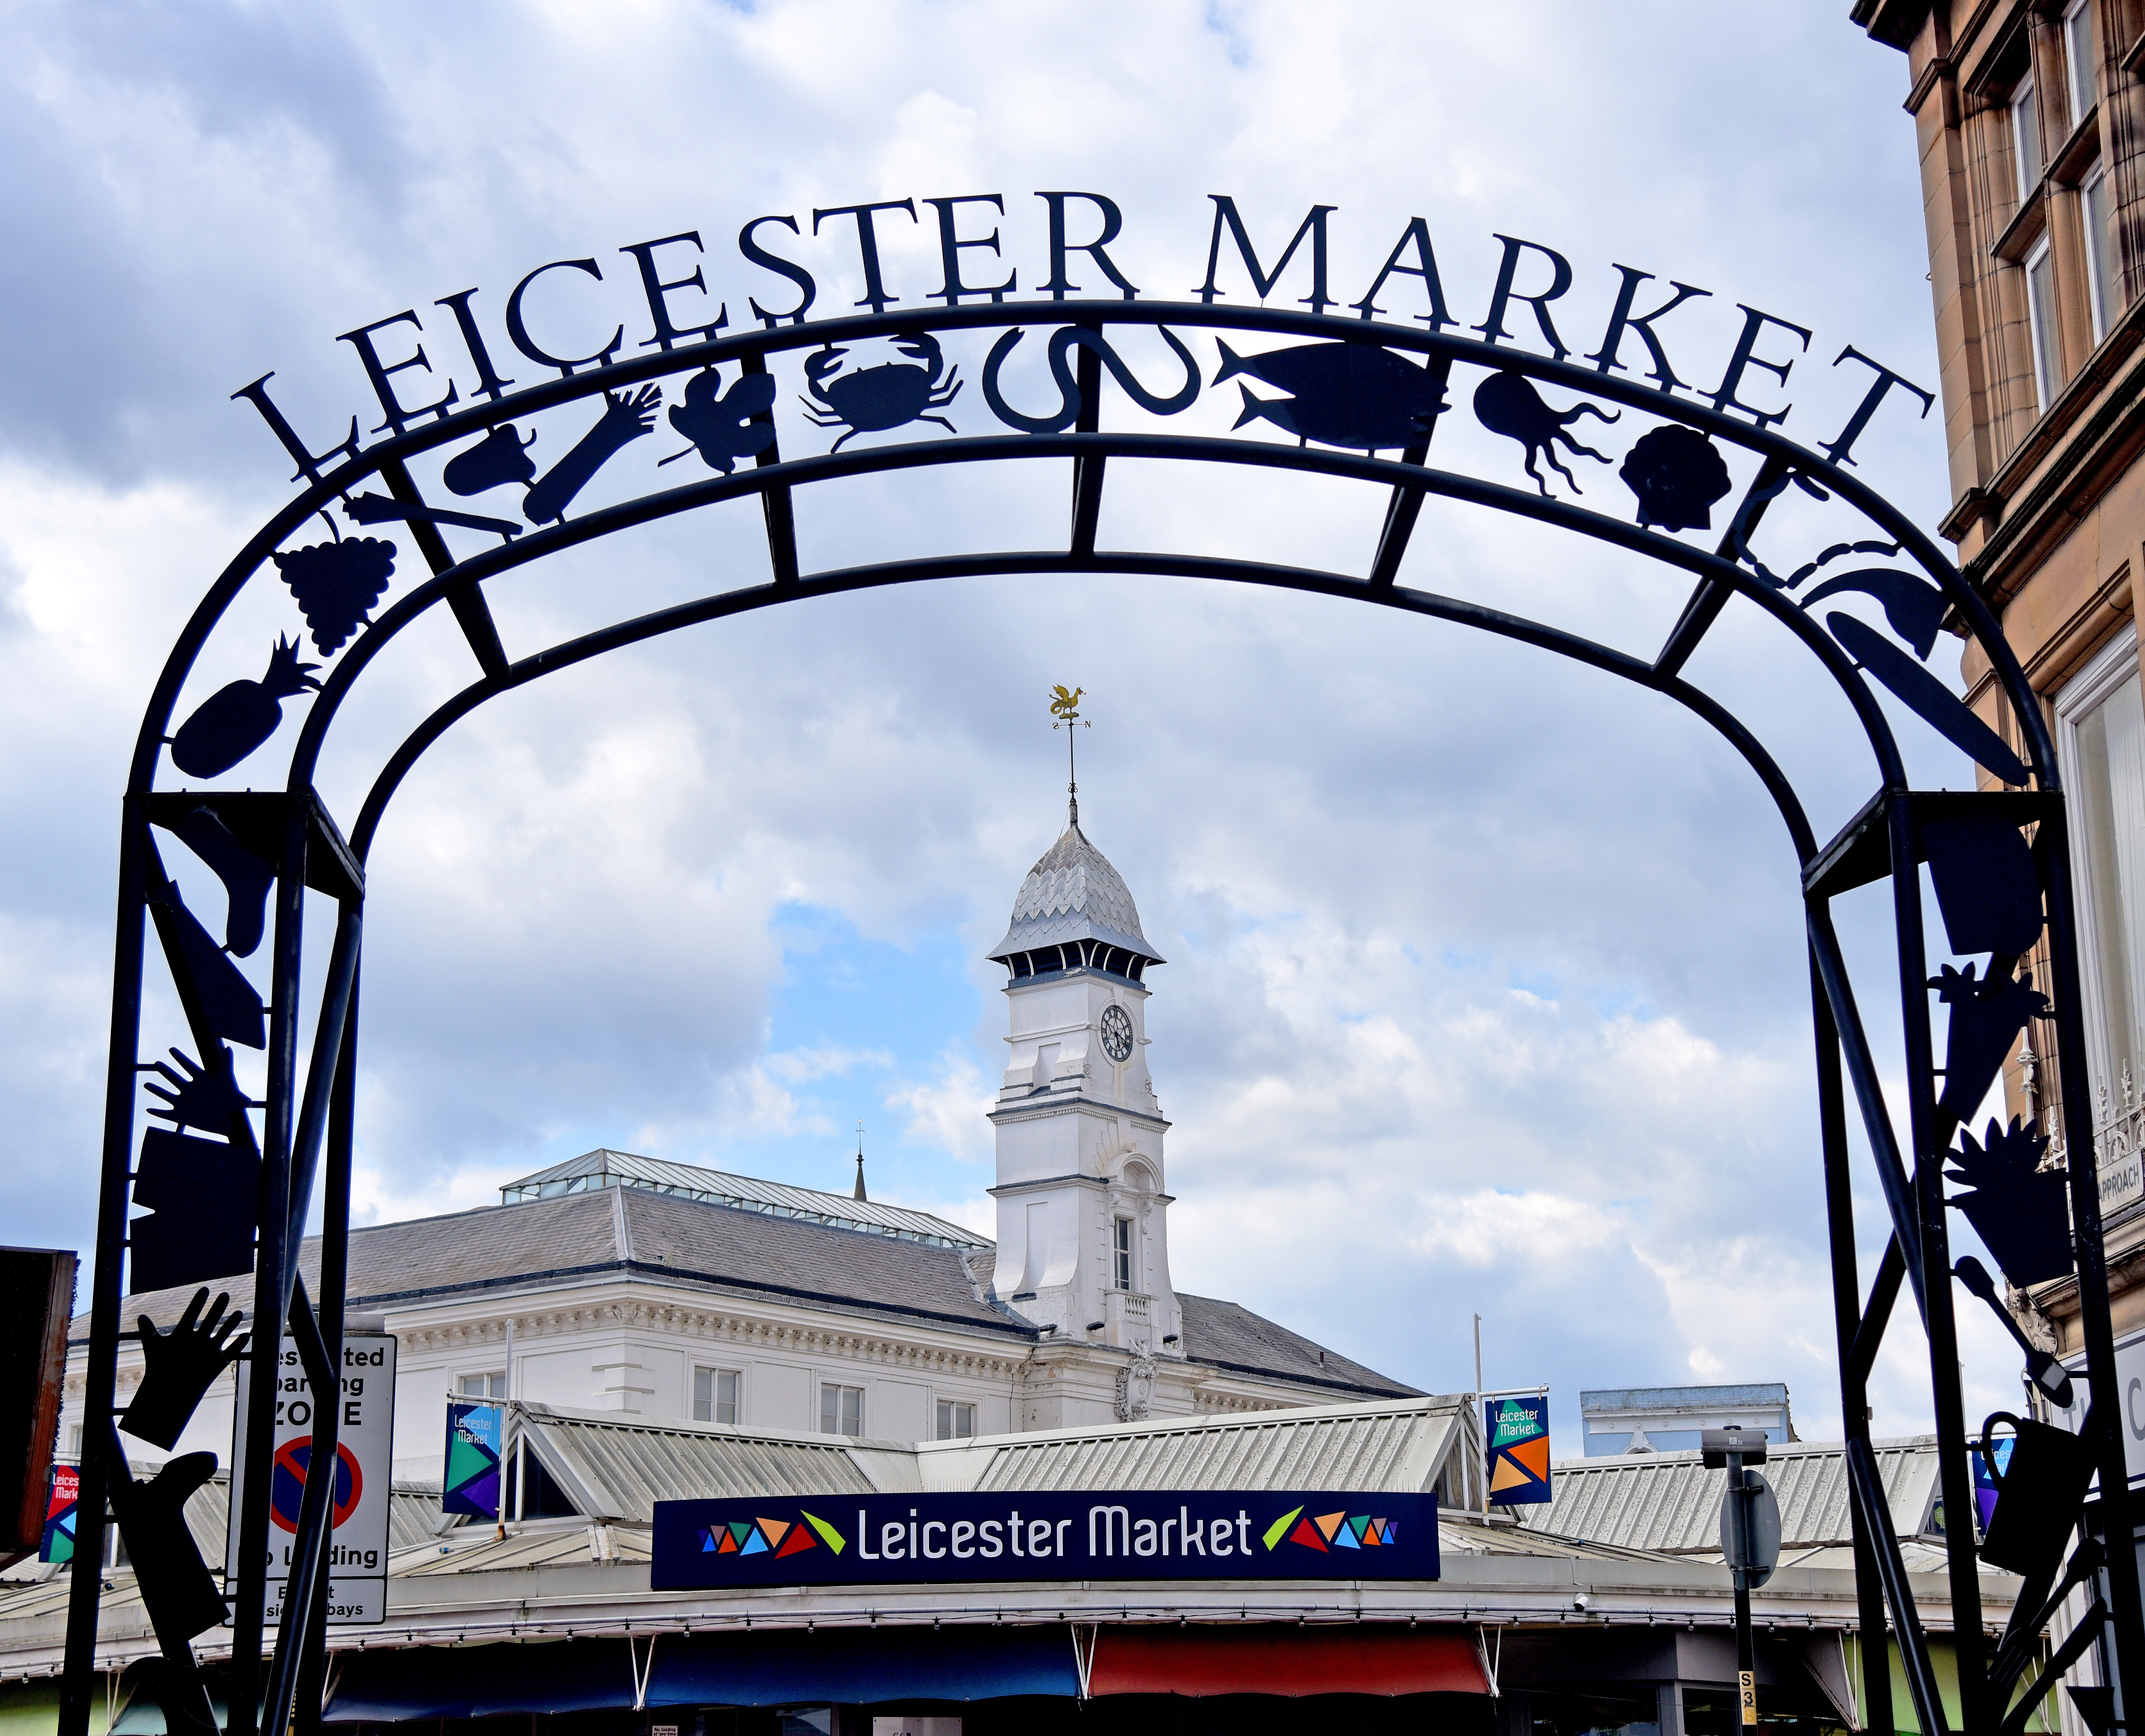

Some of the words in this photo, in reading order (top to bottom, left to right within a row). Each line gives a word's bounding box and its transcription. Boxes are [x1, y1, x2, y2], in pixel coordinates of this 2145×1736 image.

[230, 191, 1140, 483] LEICESTER
[1191, 194, 1936, 467] MARKET
[2098, 1162, 2140, 1203] APPROACH
[455, 1414, 492, 1431] Leicester
[1495, 1409, 1538, 1423] Leicester
[458, 1429, 488, 1445] Market
[1501, 1423, 1535, 1437] Market
[52, 1473, 79, 1486] Leices
[56, 1486, 78, 1500] Mark
[859, 1509, 1072, 1559] Leicester
[1089, 1506, 1252, 1556] Market
[327, 1602, 364, 1618] bays
